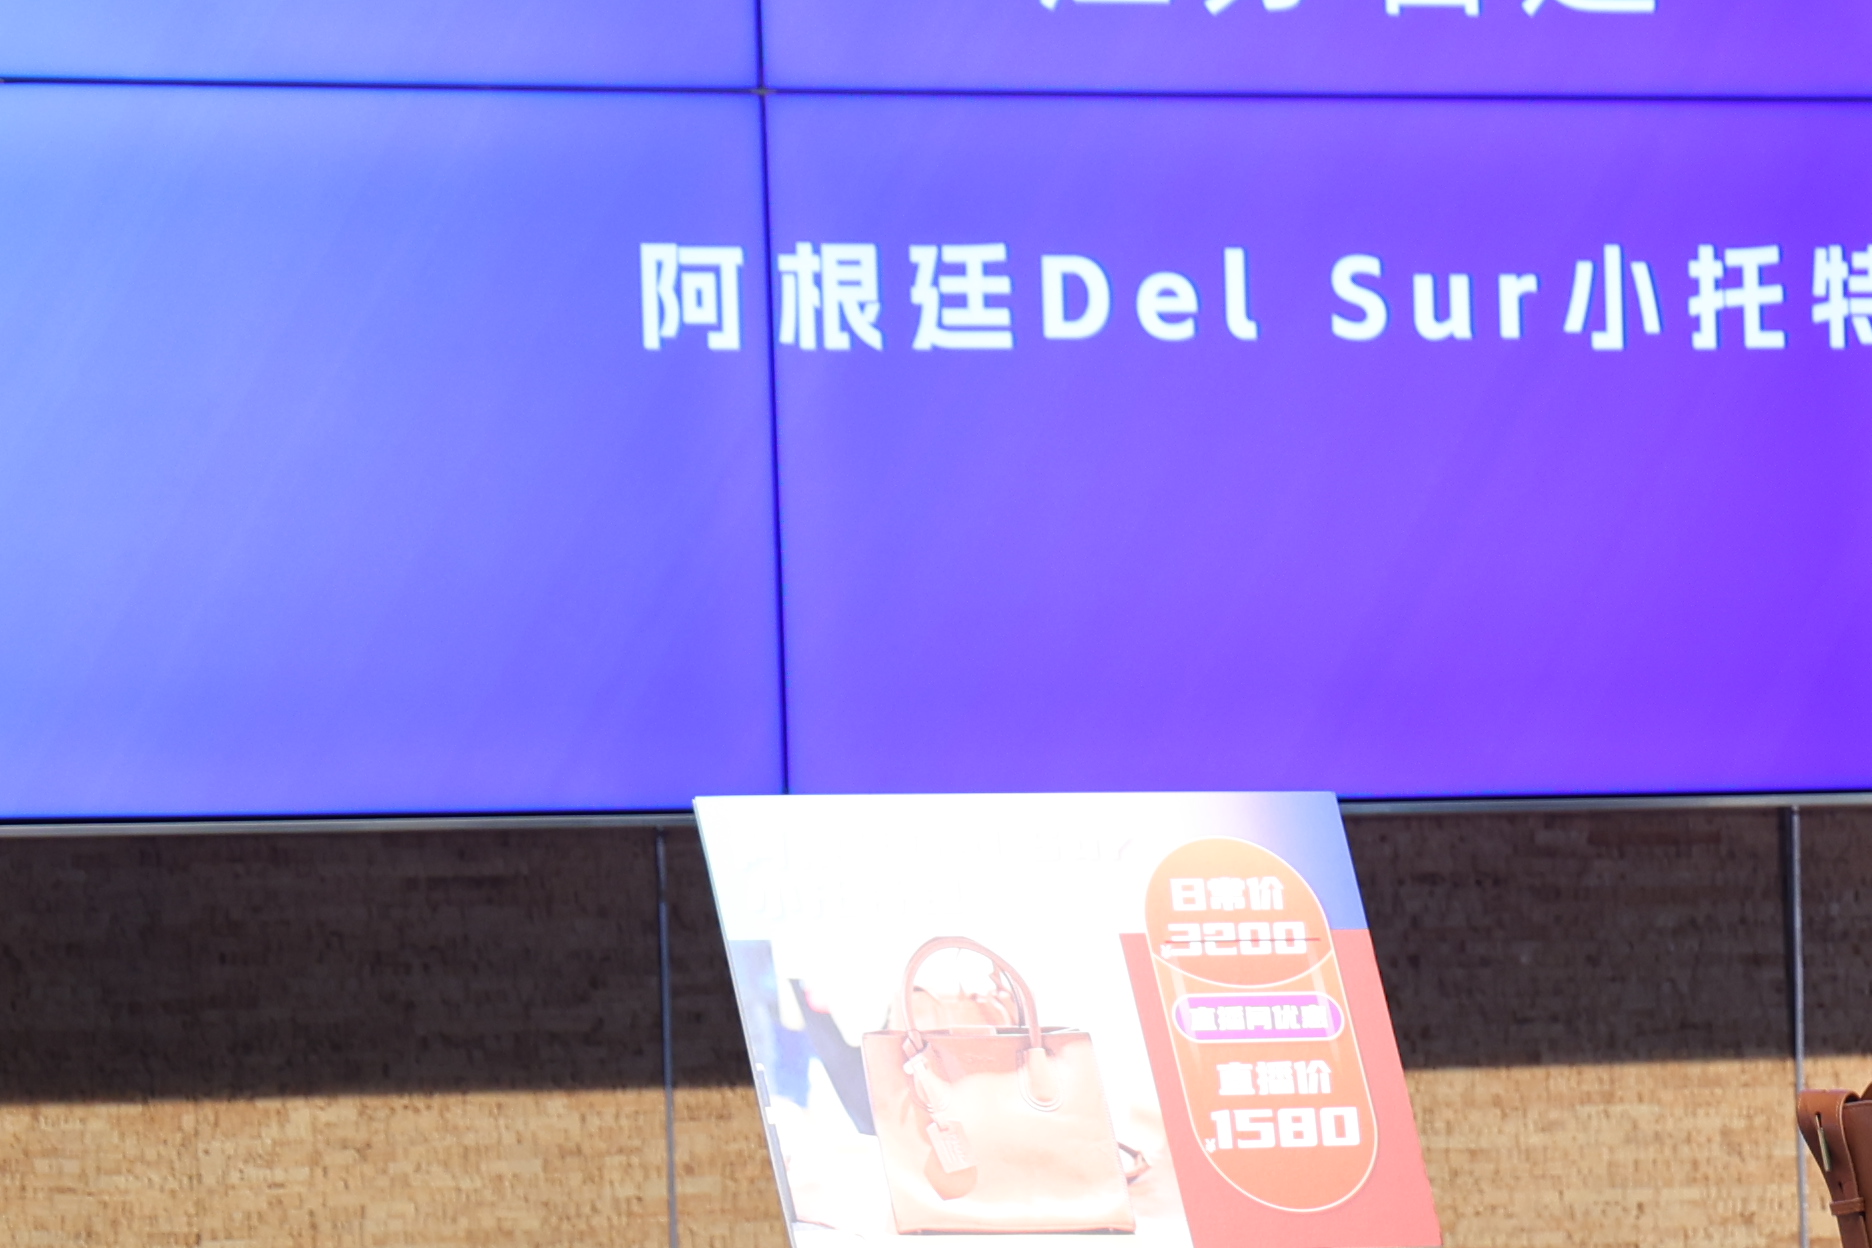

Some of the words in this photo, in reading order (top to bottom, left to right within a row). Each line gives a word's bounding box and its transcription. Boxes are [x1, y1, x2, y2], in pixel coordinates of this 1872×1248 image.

[641, 242, 1257, 350] 阿根廷Del
[1170, 876, 1284, 911] 日常价
[1216, 1060, 1331, 1095] 直播价
